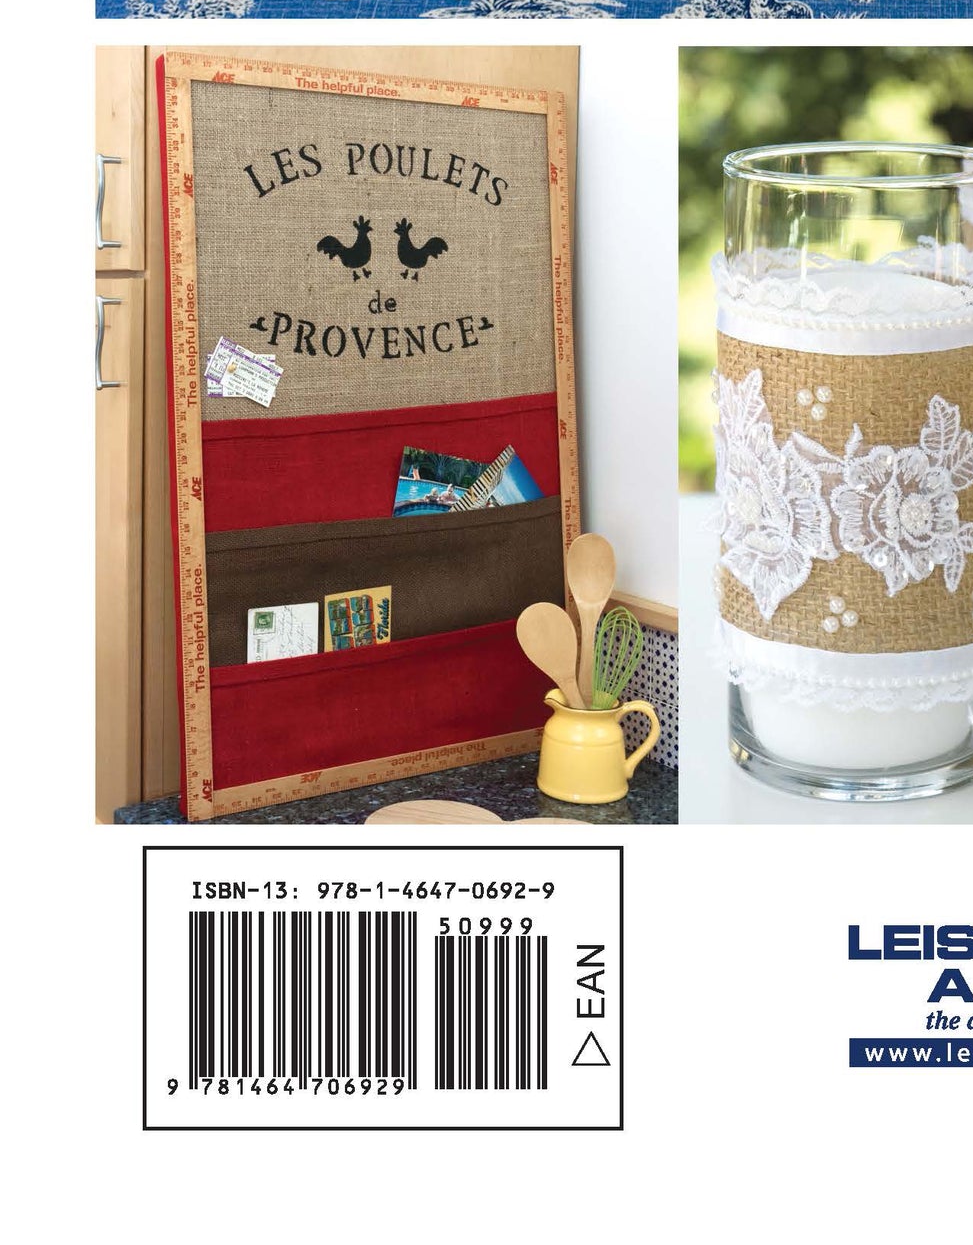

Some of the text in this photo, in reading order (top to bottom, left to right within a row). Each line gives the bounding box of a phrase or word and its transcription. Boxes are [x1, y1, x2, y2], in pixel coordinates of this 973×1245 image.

[212, 71, 236, 84] ACE
[295, 77, 401, 97] The helpful place.
[461, 95, 481, 108] ACE
[182, 172, 194, 199] ACE
[243, 142, 323, 199] LES
[344, 141, 510, 208] POULETS
[550, 162, 559, 186] ACE
[367, 289, 398, 315] de
[554, 256, 566, 365] The helpful place.
[185, 279, 198, 407] The helpful place.
[266, 310, 481, 360] PROVENCE
[190, 476, 203, 502] ACE
[564, 498, 573, 521] The
[193, 563, 207, 693] The helpful place.
[376, 597, 391, 641] Florida
[202, 778, 213, 803] ACE
[192, 881, 555, 900] ISBN-13: 978-1-4647-0692-9
[439, 917, 533, 935] 50999
[576, 944, 605, 1019] EAN
[925, 1010, 961, 1031] the
[167, 1078, 405, 1096] 9 781464 706929
